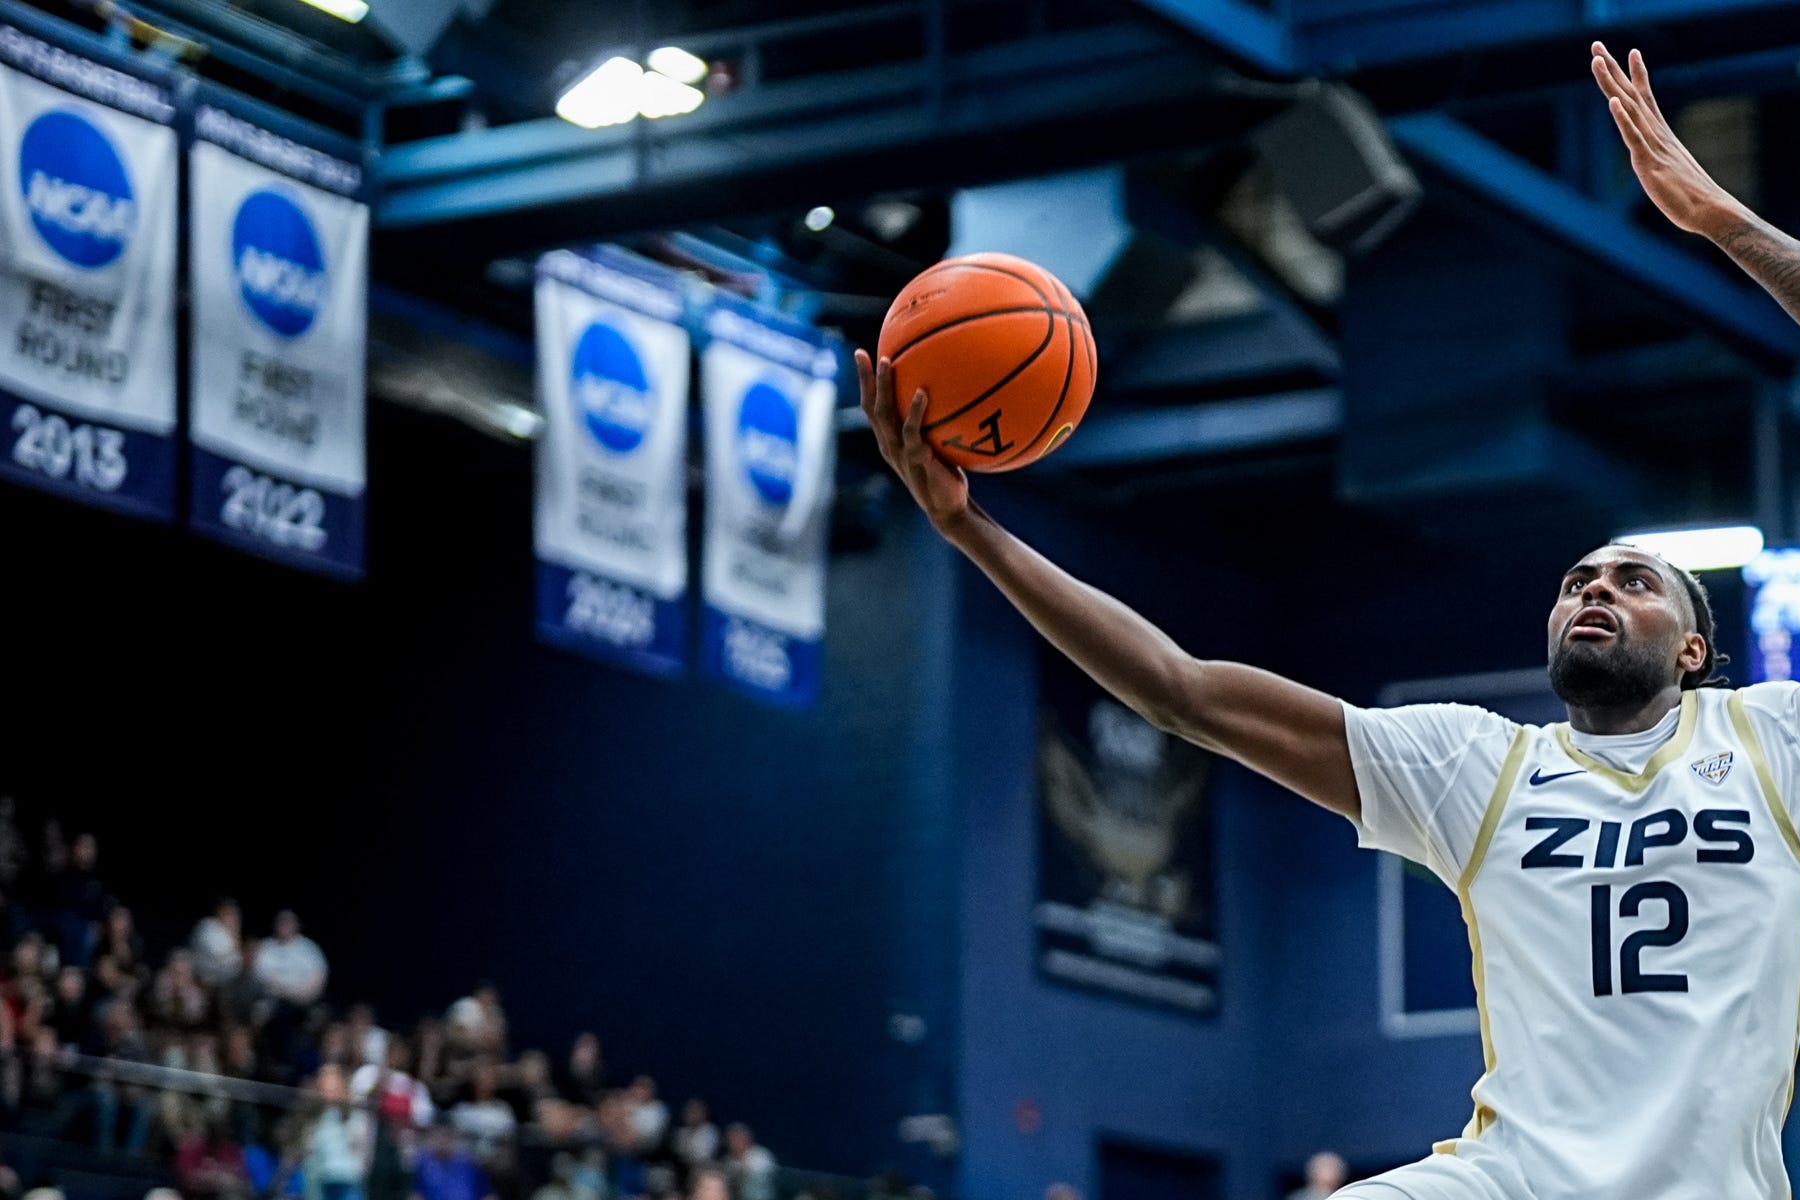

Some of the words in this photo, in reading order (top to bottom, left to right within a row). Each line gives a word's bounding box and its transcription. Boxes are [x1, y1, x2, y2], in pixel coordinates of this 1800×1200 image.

[11, 403, 128, 493] 2013
[1521, 808, 1755, 870] ZIPS
[1591, 880, 1689, 997] 12
